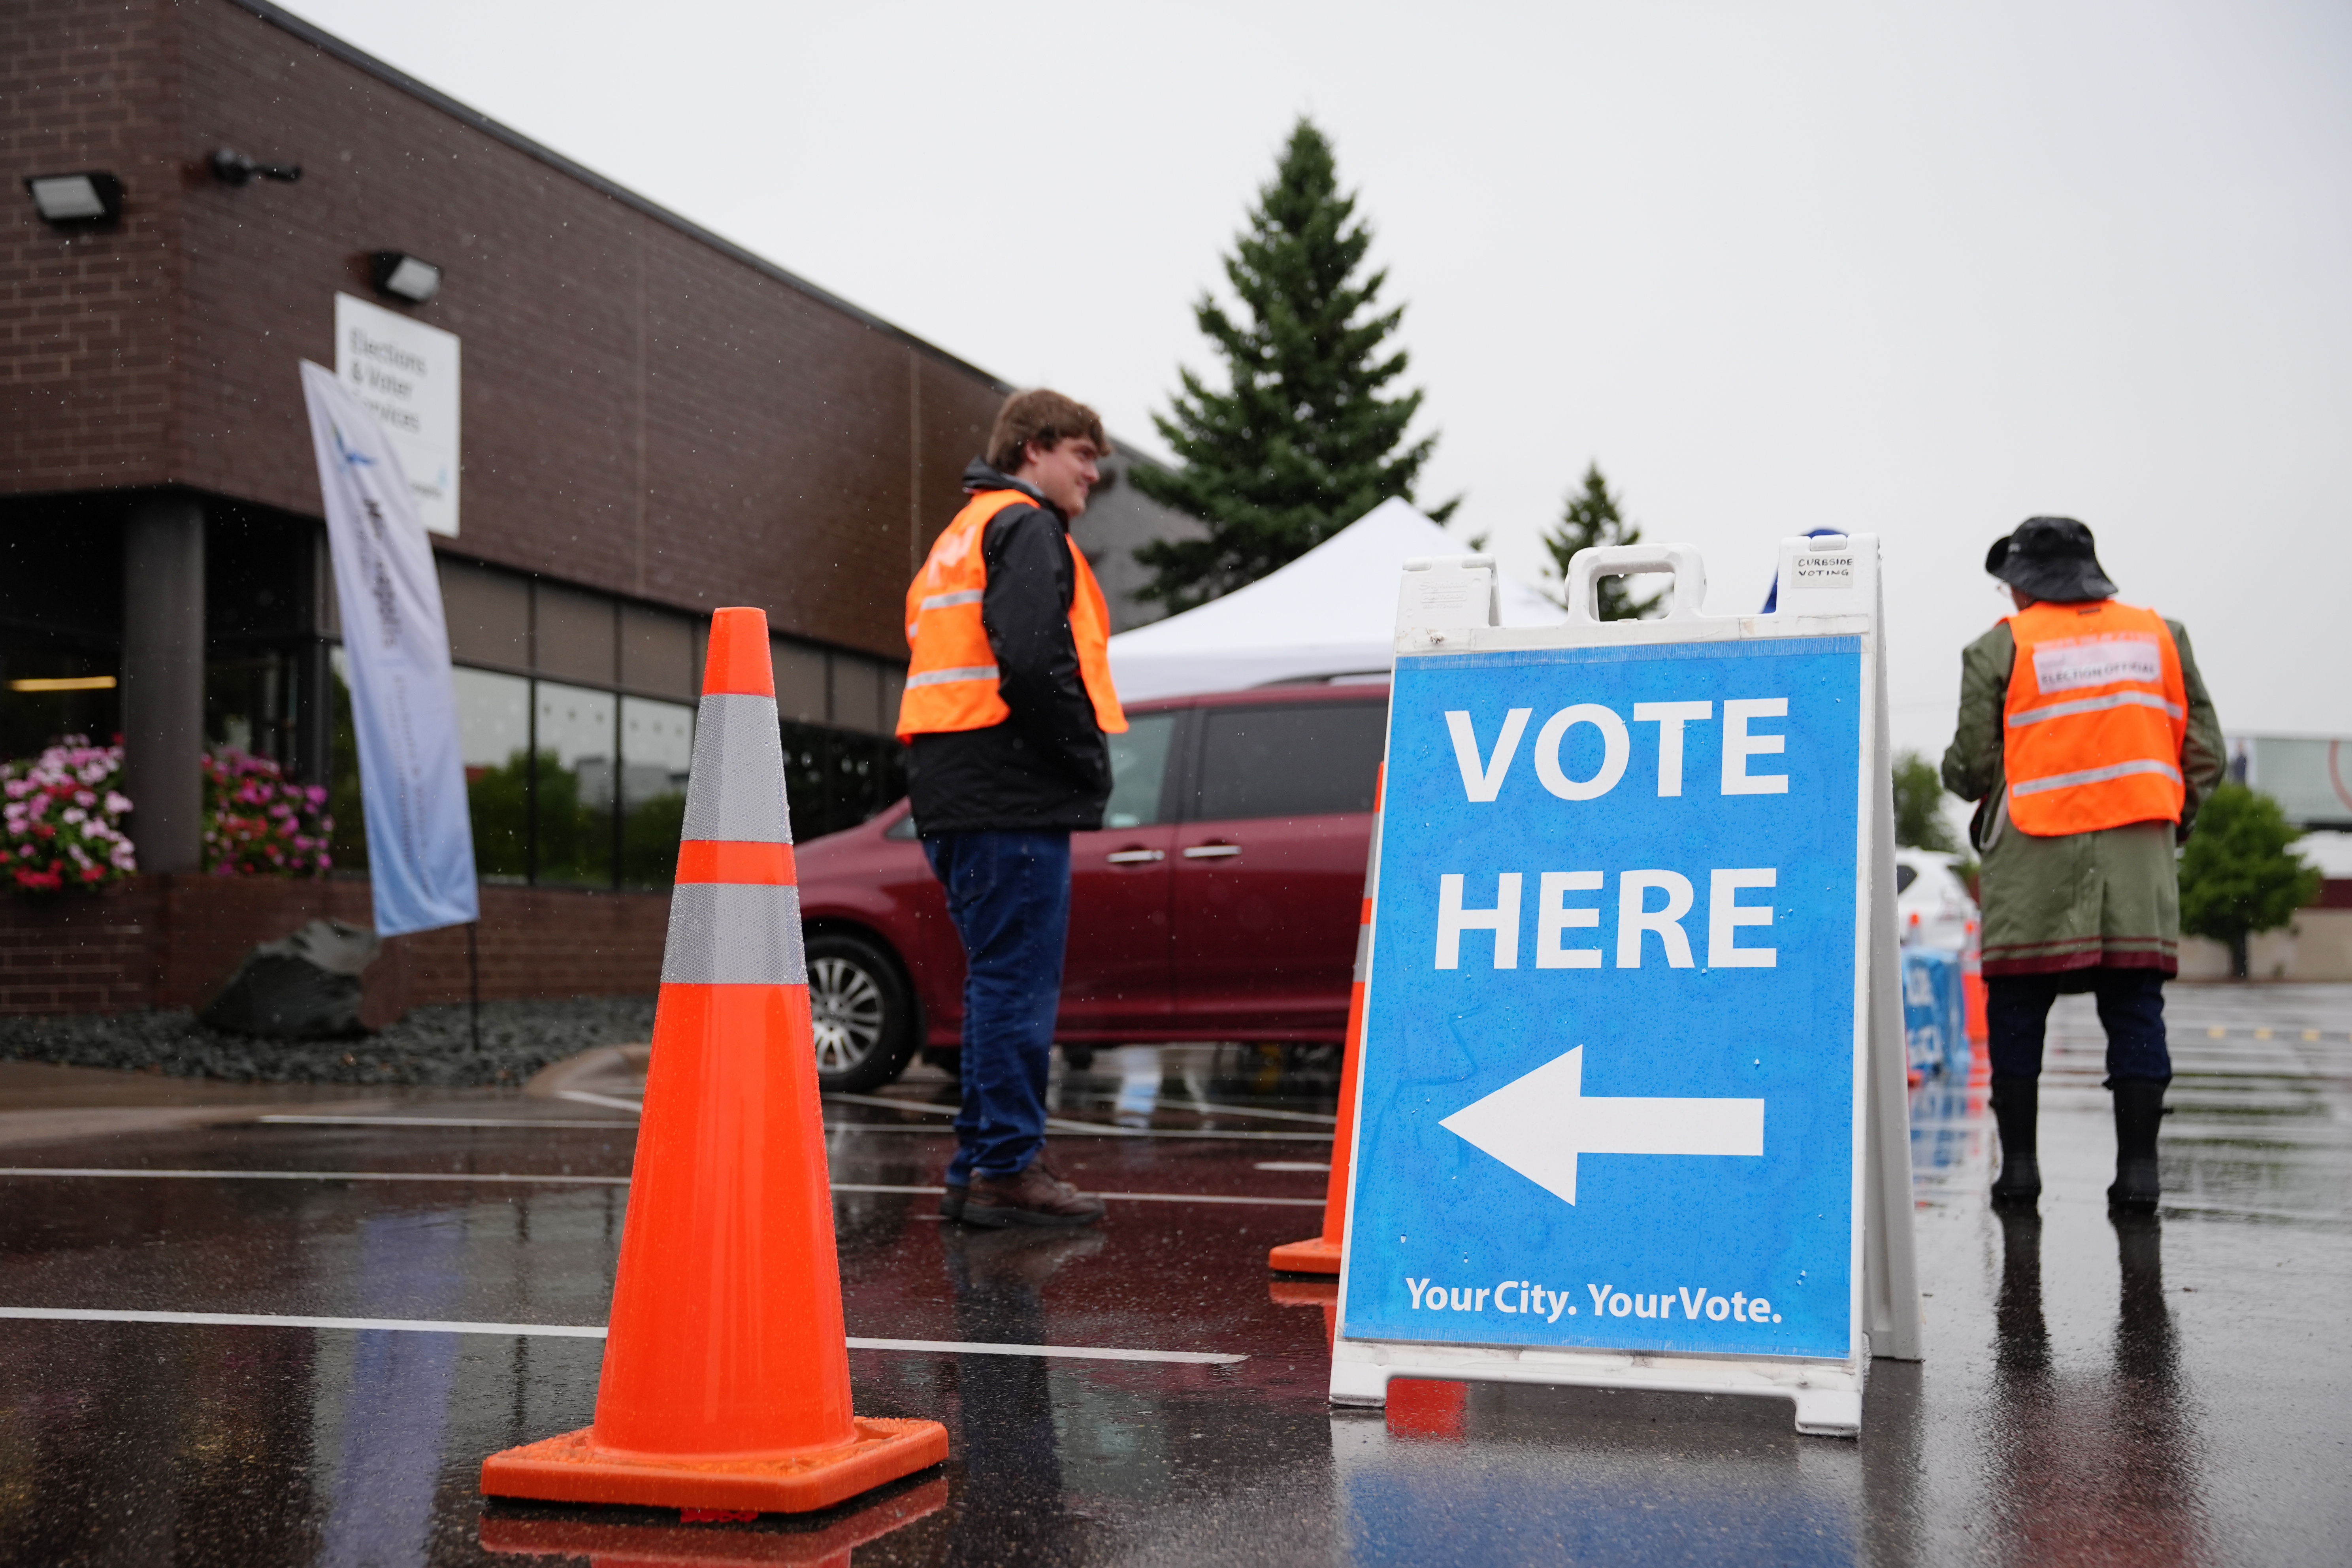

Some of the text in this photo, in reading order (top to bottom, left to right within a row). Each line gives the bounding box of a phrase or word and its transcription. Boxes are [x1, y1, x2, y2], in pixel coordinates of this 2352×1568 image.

[1798, 558, 1853, 567] CURBSIDE
[2041, 661, 2154, 684] ELECTION OFFICIAL
[1444, 697, 1788, 802] VOTE
[1434, 868, 1777, 969] HERE
